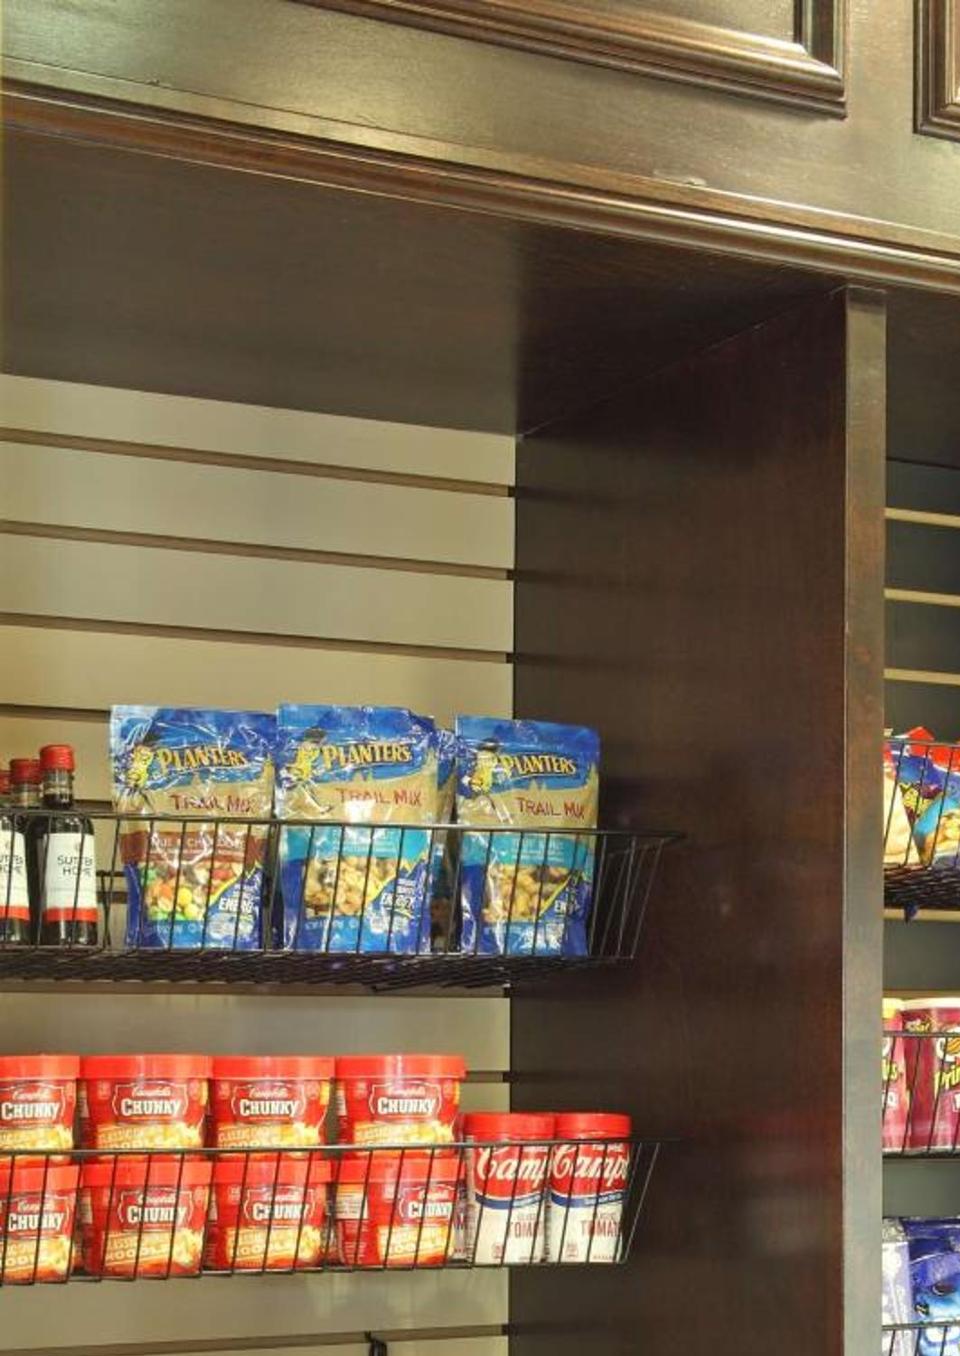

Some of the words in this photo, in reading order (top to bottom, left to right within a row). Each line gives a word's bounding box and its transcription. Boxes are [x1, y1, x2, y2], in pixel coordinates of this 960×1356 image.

[320, 743, 411, 769] PLANTERS
[499, 754, 576, 779] PLANTERS
[394, 789, 422, 806] MIX
[516, 797, 561, 816] TRAIL
[2, 1101, 60, 1120] CHUNKY
[121, 1098, 182, 1117] CHUNKY
[239, 1098, 300, 1117] CHUNKY
[377, 1097, 437, 1115] CHUNKY
